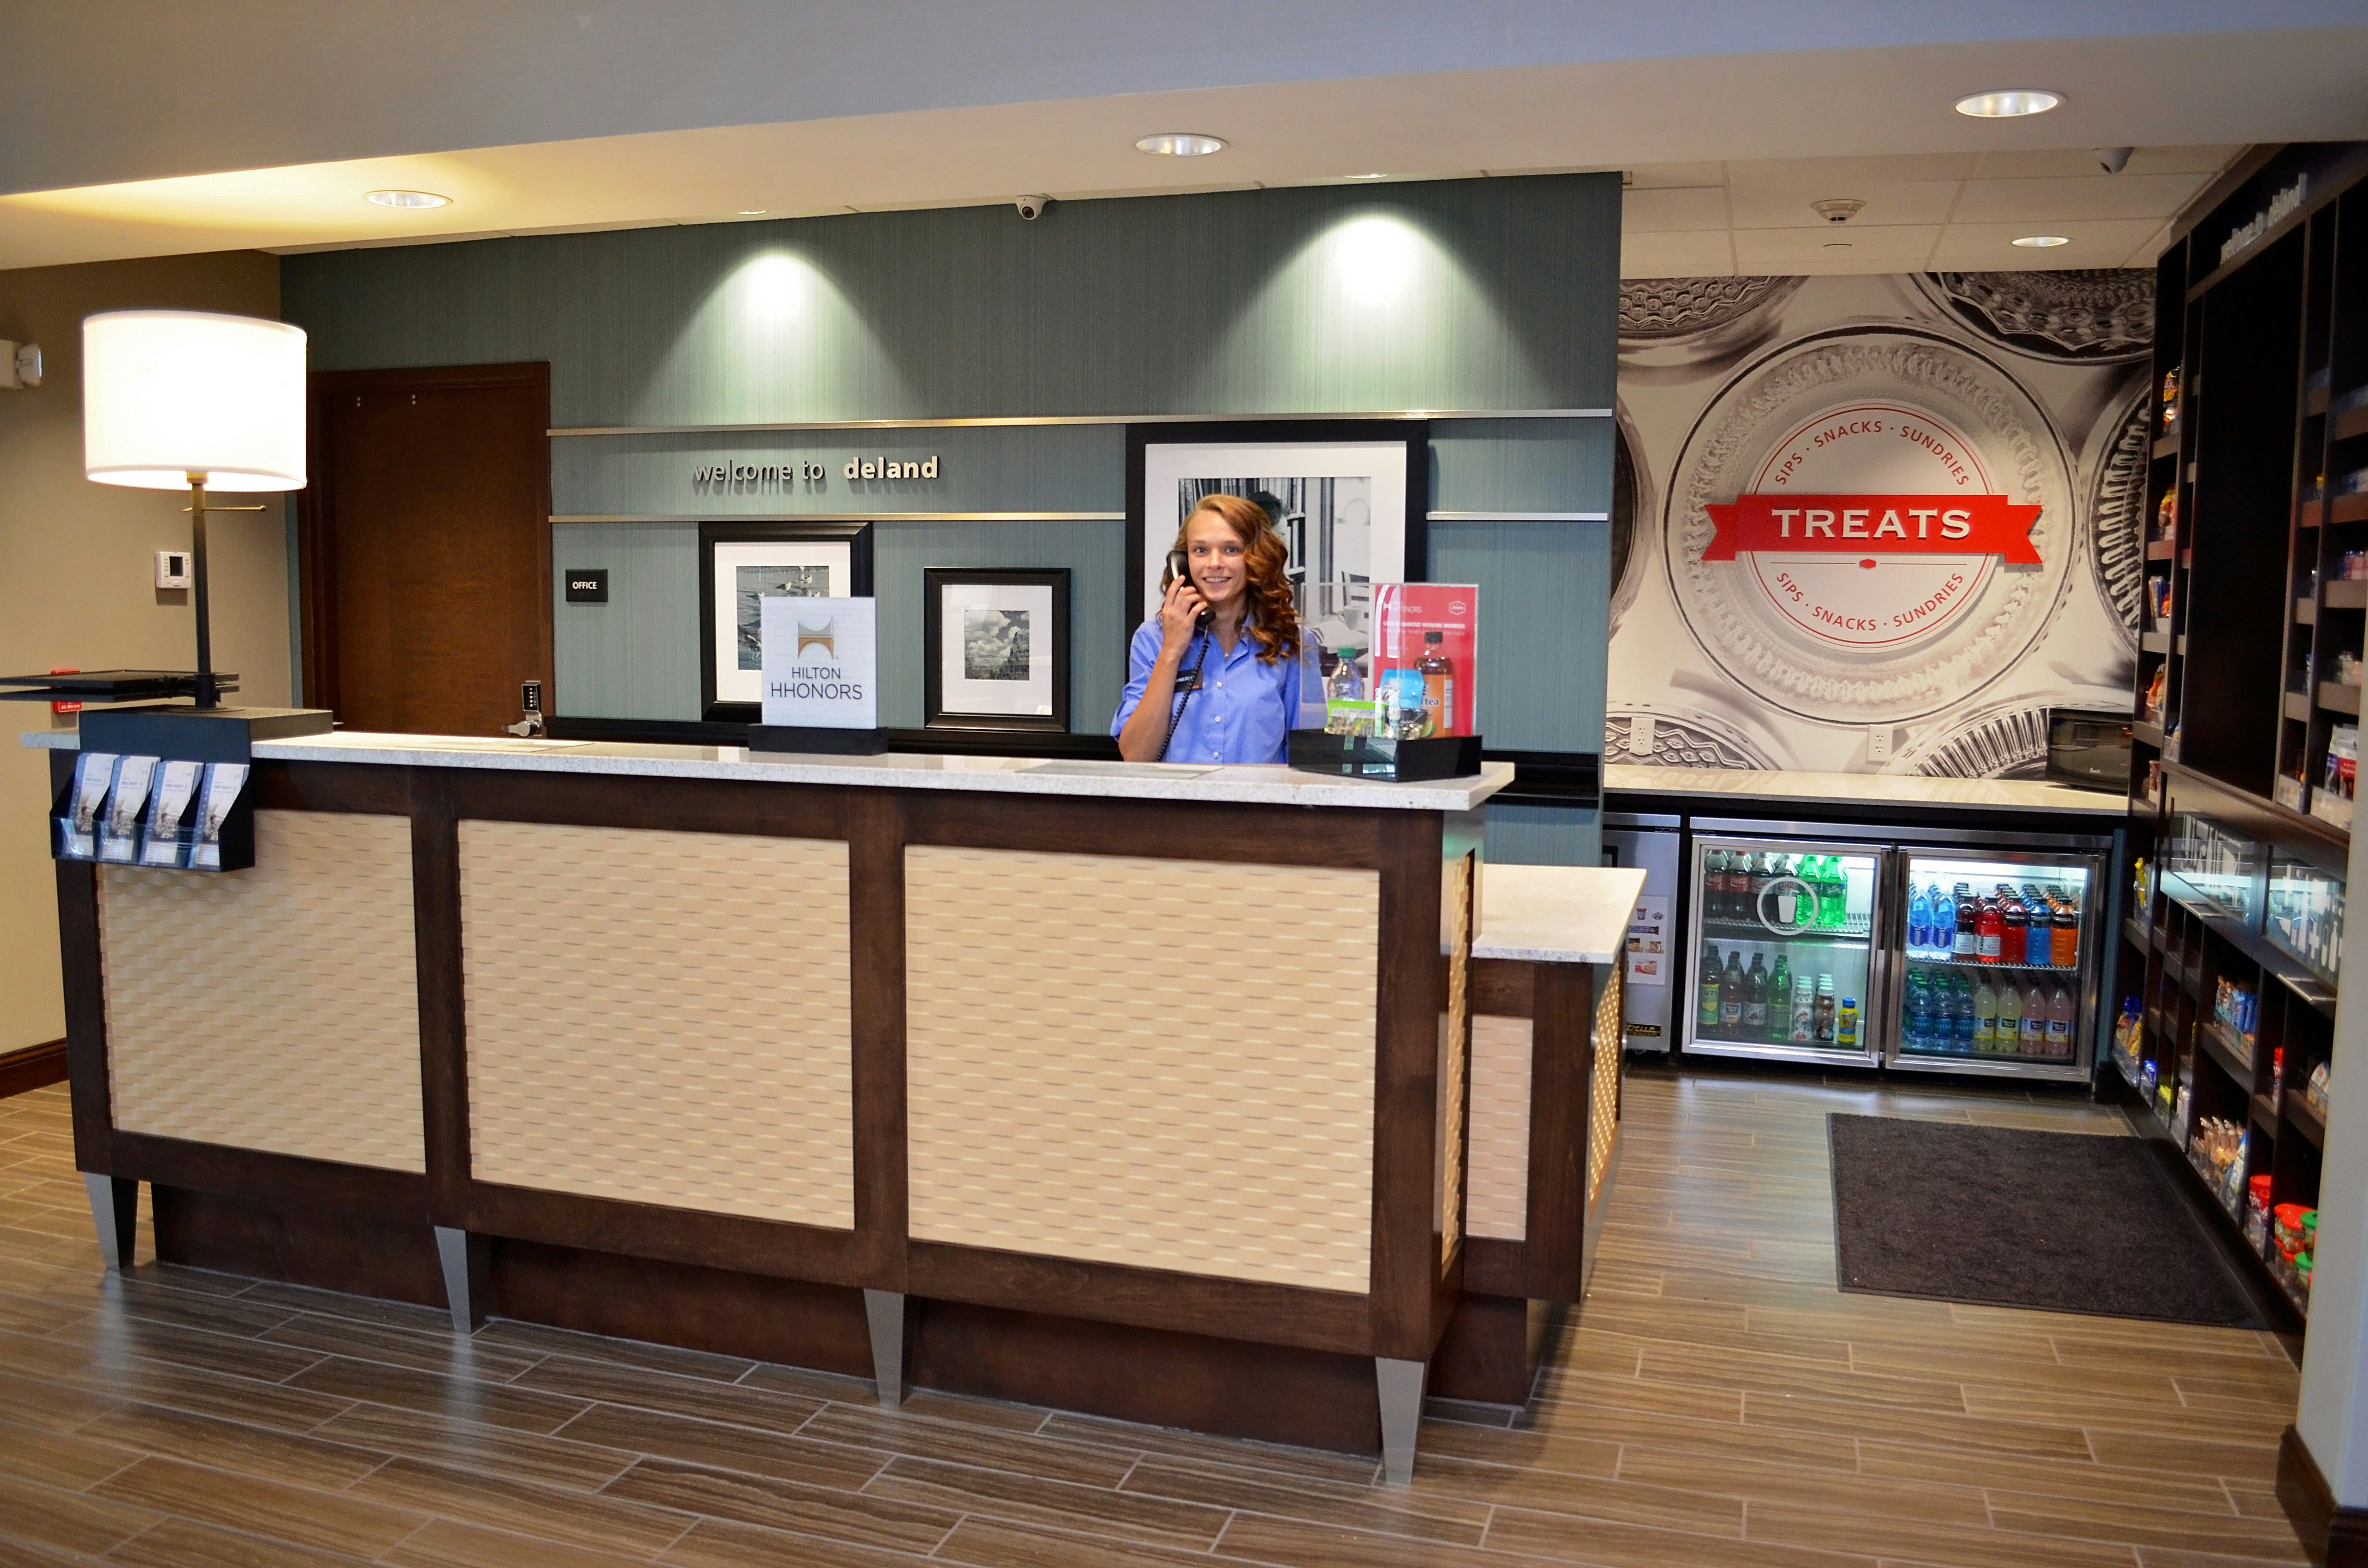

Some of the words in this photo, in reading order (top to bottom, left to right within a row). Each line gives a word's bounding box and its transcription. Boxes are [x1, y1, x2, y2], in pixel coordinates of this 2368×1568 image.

[1775, 453, 1802, 485] SIPS
[1814, 421, 1882, 447] SNACKS
[1900, 426, 1969, 485] SUNDRIES
[694, 460, 793, 481] welcome
[801, 461, 824, 480] to
[843, 456, 938, 479] deland
[1771, 509, 1971, 539] TREATS
[572, 581, 597, 589] OFFICE
[1776, 573, 1803, 602] SIPS
[1812, 606, 1876, 631] SNACKS
[1893, 573, 1963, 627] SUNDRIES
[792, 667, 841, 679] HILTON
[771, 683, 863, 700] HHONORS
